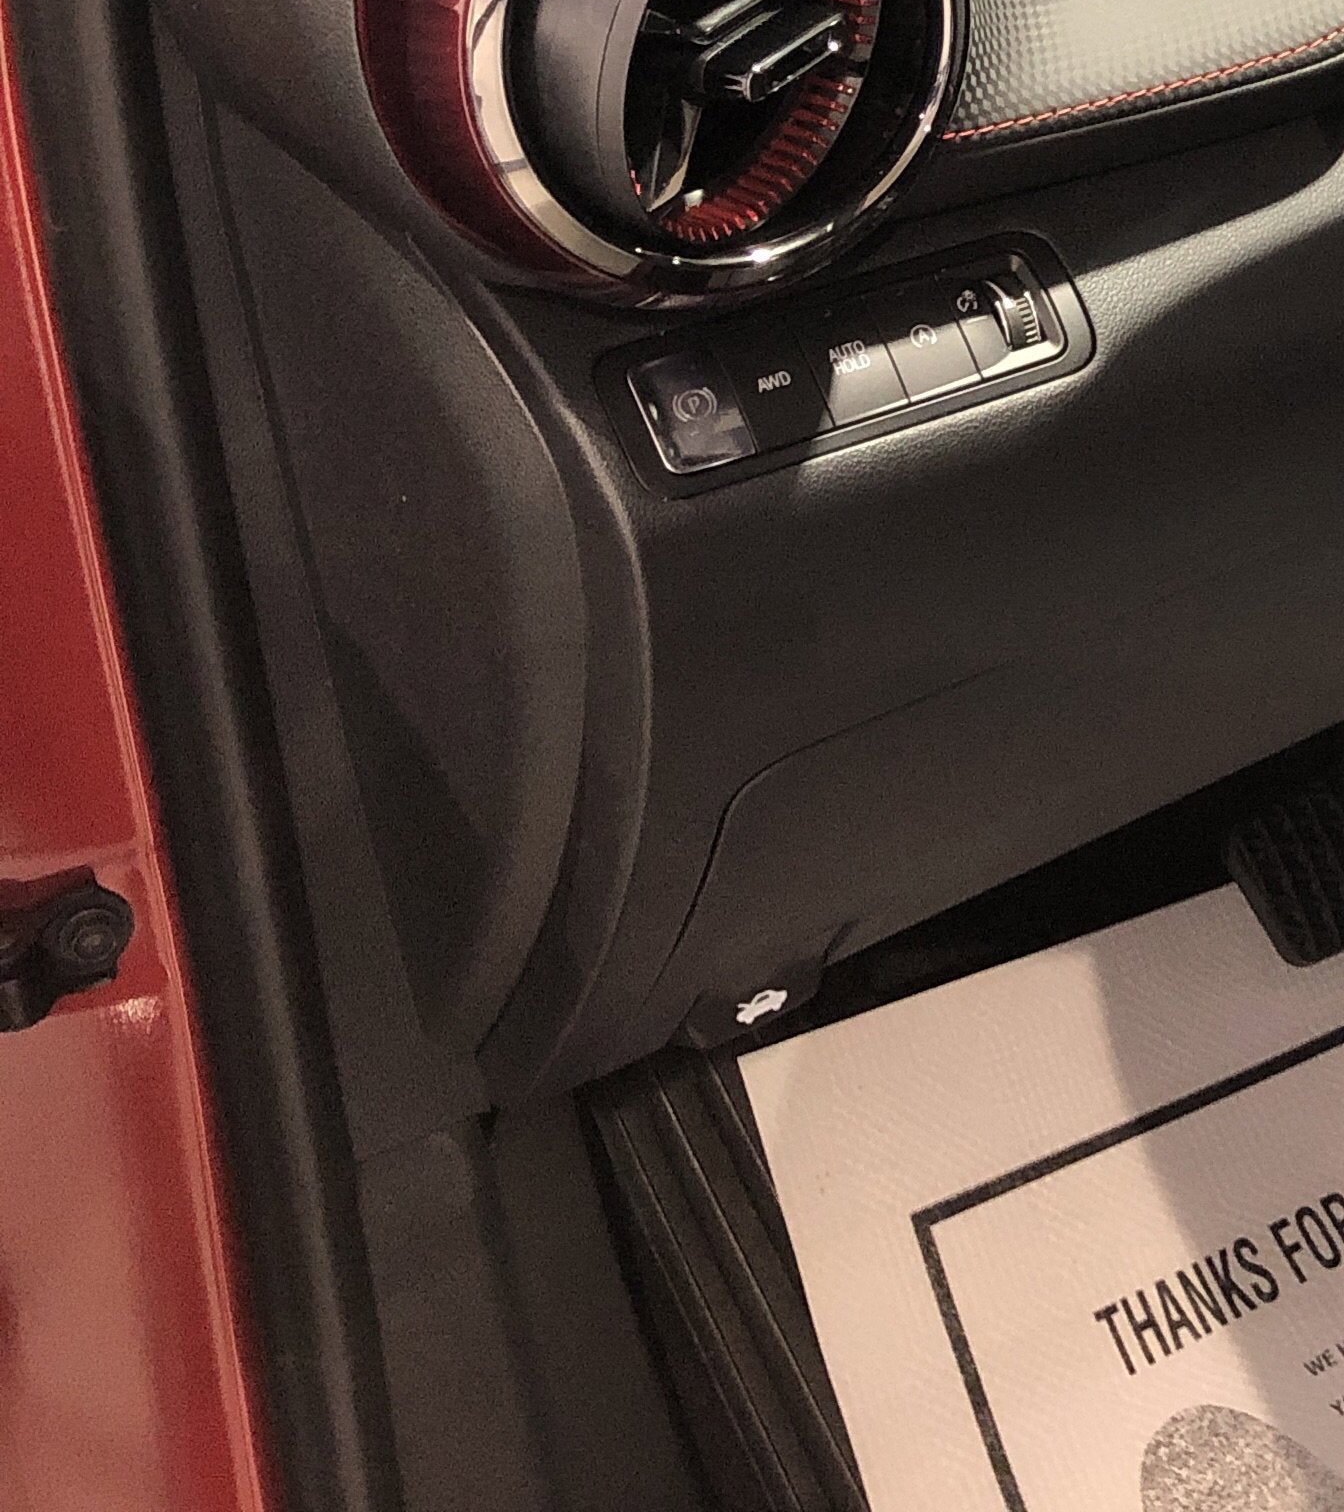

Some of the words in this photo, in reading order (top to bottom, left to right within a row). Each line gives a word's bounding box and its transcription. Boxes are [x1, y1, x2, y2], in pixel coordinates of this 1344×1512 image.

[828, 339, 866, 363] AUTO
[832, 353, 871, 376] HOLD
[757, 370, 792, 394] AWD
[1095, 1237, 1280, 1375] THANKS
[1303, 1351, 1336, 1378] WE
